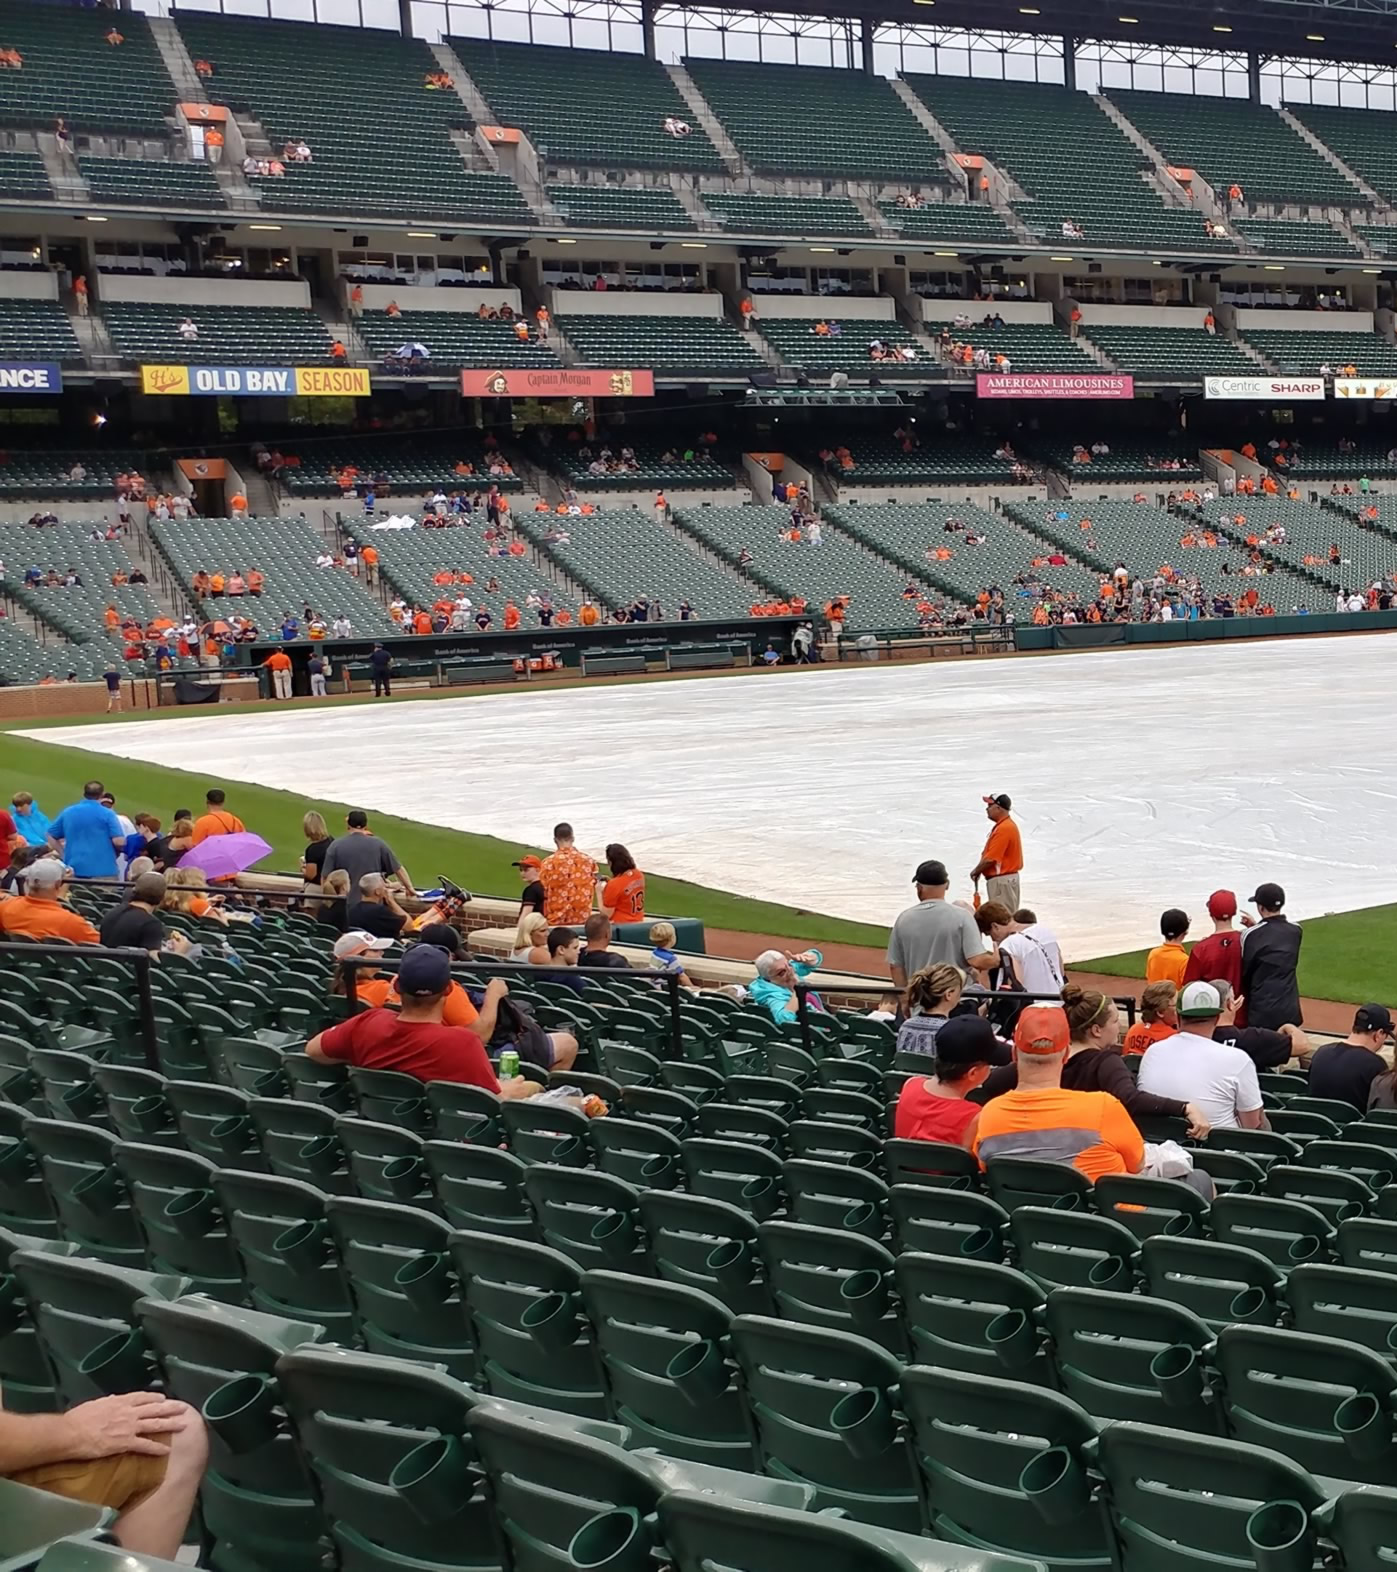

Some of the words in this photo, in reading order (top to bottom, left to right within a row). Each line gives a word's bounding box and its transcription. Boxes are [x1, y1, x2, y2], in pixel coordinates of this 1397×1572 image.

[0, 369, 49, 388] NCE
[197, 369, 242, 391] OLD
[302, 370, 364, 392] SEASON
[527, 373, 559, 387] Captain
[559, 372, 591, 386] Morgan
[987, 378, 1049, 388] AMERICAN
[1052, 379, 1124, 389] LIMOUSINES
[1221, 379, 1261, 391] Centric
[1271, 384, 1321, 393] SHARP
[632, 891, 645, 914] 13
